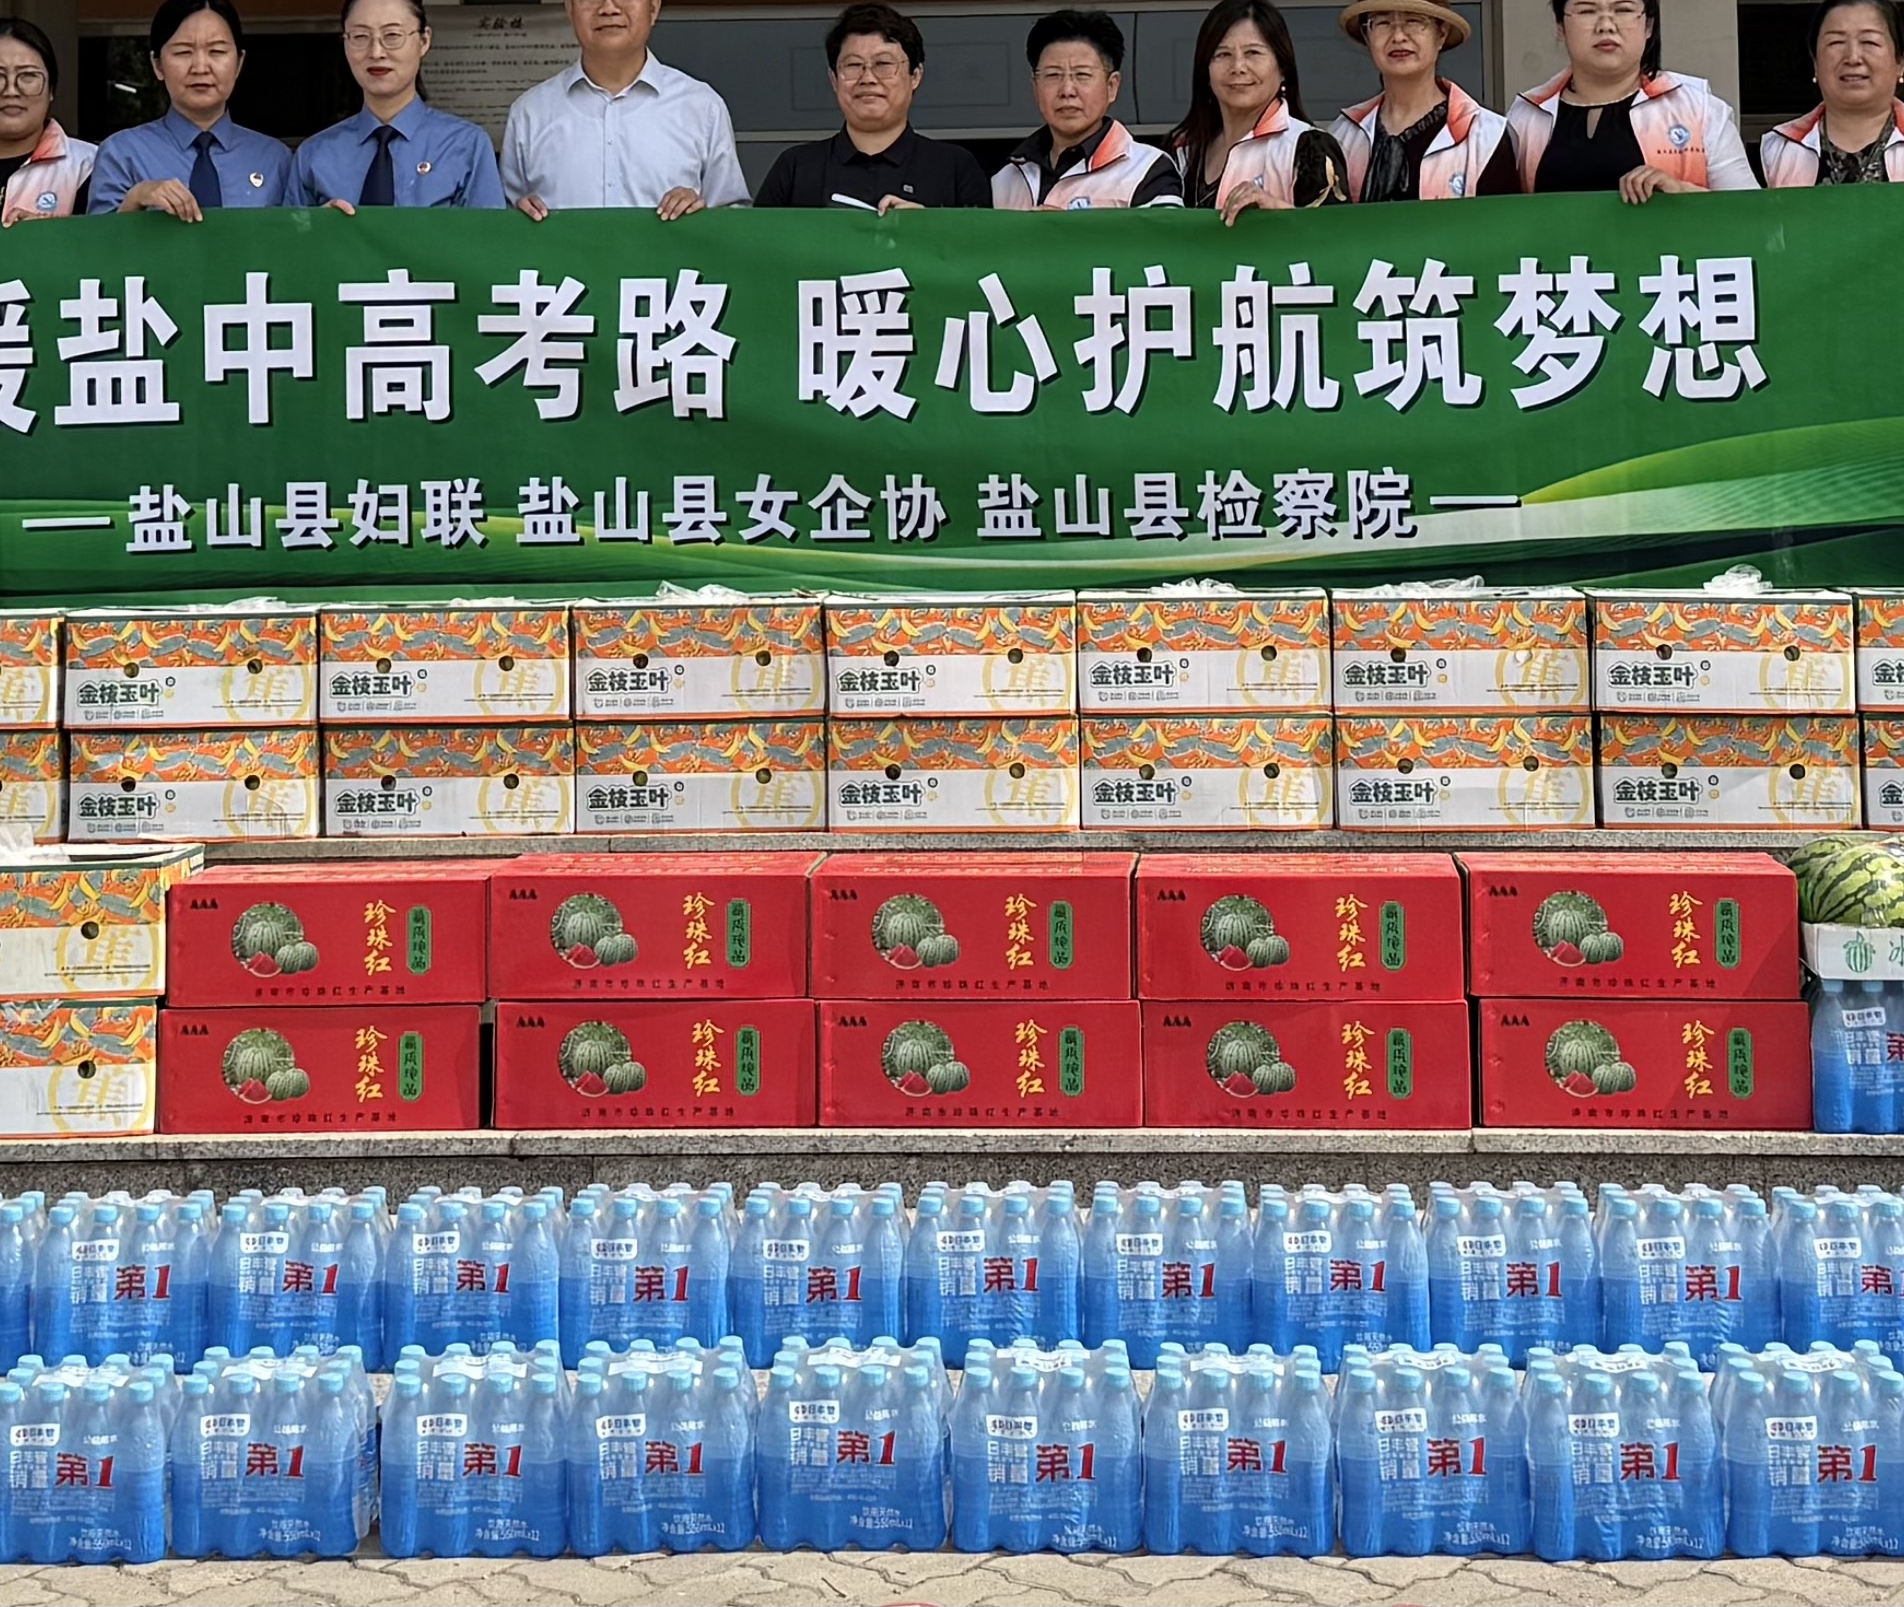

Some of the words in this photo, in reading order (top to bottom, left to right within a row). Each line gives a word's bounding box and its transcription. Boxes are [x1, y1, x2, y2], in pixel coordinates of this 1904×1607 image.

[796, 255, 1769, 421] 暖心护航筑梦想
[517, 472, 945, 547] 盐山县女企协
[331, 673, 412, 695] 金枝玉叶
[588, 670, 669, 692] 金枝玉叶
[839, 670, 920, 692] 金枝玉叶
[1092, 663, 1173, 685] 金枝玉叶
[1345, 663, 1426, 685] 金枝玉叶
[1610, 664, 1691, 686] 金枝玉叶
[79, 682, 160, 704] 金枝玉叶
[588, 787, 669, 809] 金枝玉叶
[841, 782, 922, 804] 金枝玉叶
[1094, 781, 1175, 803] 金枝玉叶
[1351, 781, 1432, 803] 金枝玉叶
[1615, 779, 1696, 801] 金枝玉叶
[79, 795, 160, 817] 金枝玉叶
[337, 791, 418, 813] 金枝玉叶
[364, 901, 394, 974] 珍珠红
[683, 894, 715, 967] 珍珠红
[1006, 895, 1036, 969] 珍珠红
[1335, 895, 1366, 971] 珍珠红
[1670, 892, 1701, 968] 珍珠红
[355, 1027, 386, 1101] 珍珠红
[693, 1021, 723, 1096] 珍珠红
[1016, 1021, 1046, 1096] 珍珠红
[1342, 1023, 1373, 1098] 珍珠红
[1682, 1021, 1714, 1095] 珍珠红
